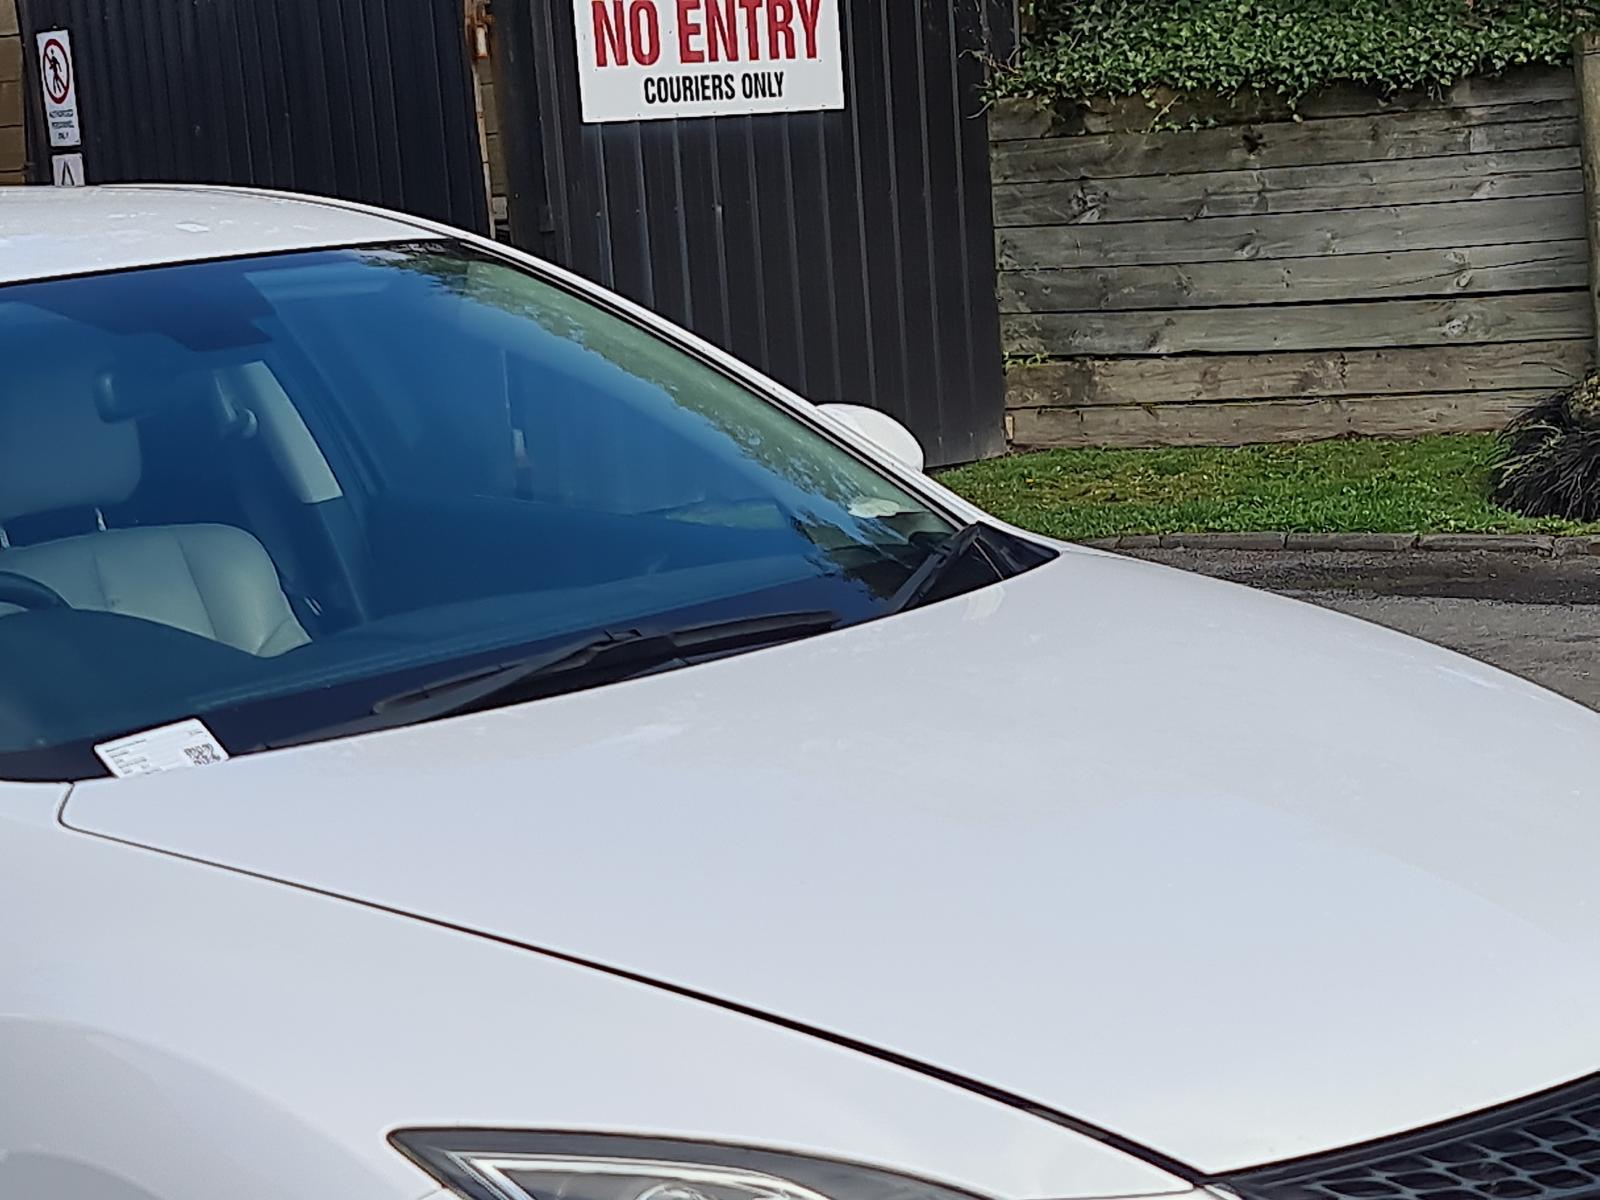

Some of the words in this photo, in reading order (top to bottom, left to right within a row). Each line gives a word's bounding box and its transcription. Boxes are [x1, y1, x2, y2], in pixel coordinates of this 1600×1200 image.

[592, 0, 660, 67] NO
[677, 0, 822, 64] ENTRY
[644, 74, 735, 104] COURIERS
[742, 72, 784, 99] ONLY
